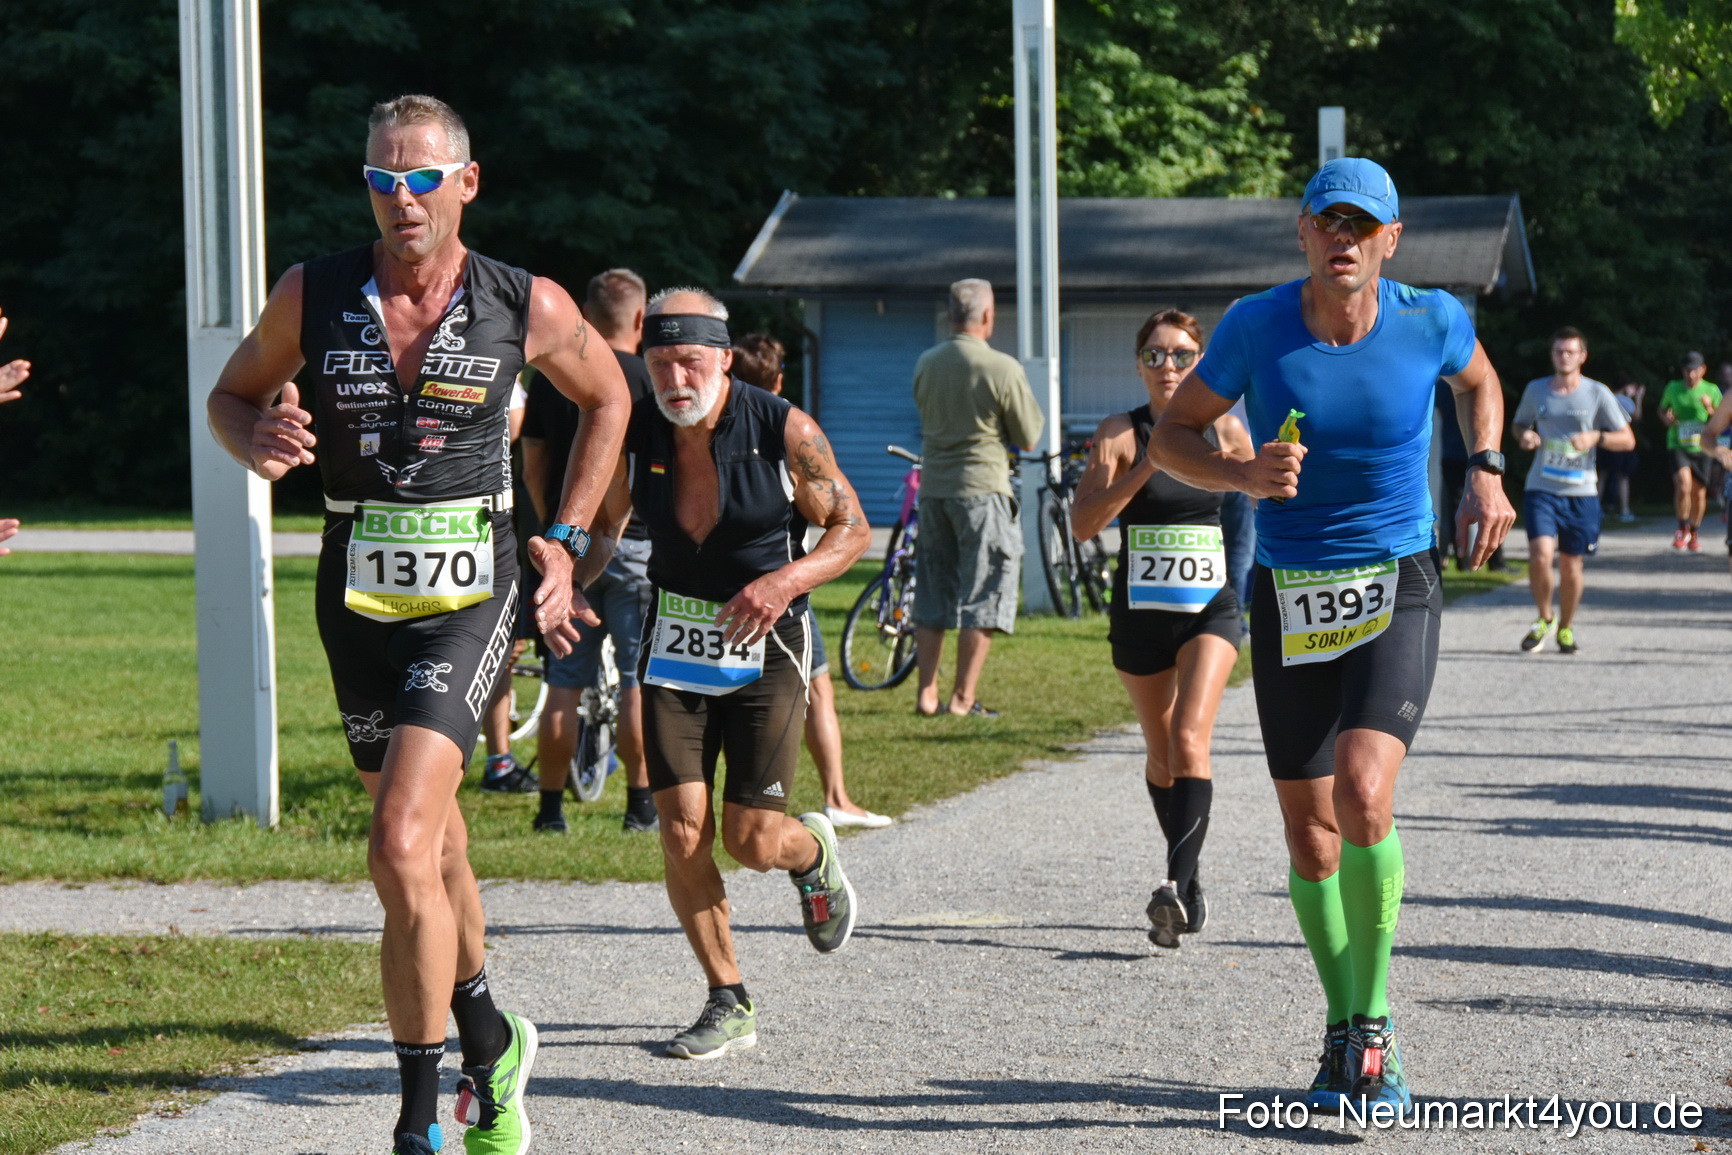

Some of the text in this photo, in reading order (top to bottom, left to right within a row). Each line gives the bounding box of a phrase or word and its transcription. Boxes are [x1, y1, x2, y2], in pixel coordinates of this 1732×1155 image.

[344, 313, 369, 321] Team
[336, 382, 390, 395] uvex
[424, 383, 484, 400] PowerBar
[336, 399, 388, 410] Continental
[364, 511, 475, 537] BOCK
[1138, 531, 1213, 547] BOCK
[366, 550, 477, 588] 1370
[1141, 556, 1214, 581] 2703
[668, 594, 723, 617] BOC
[1294, 583, 1386, 625] 1393
[666, 624, 750, 661] 2834
[763, 789, 784, 797] adidas
